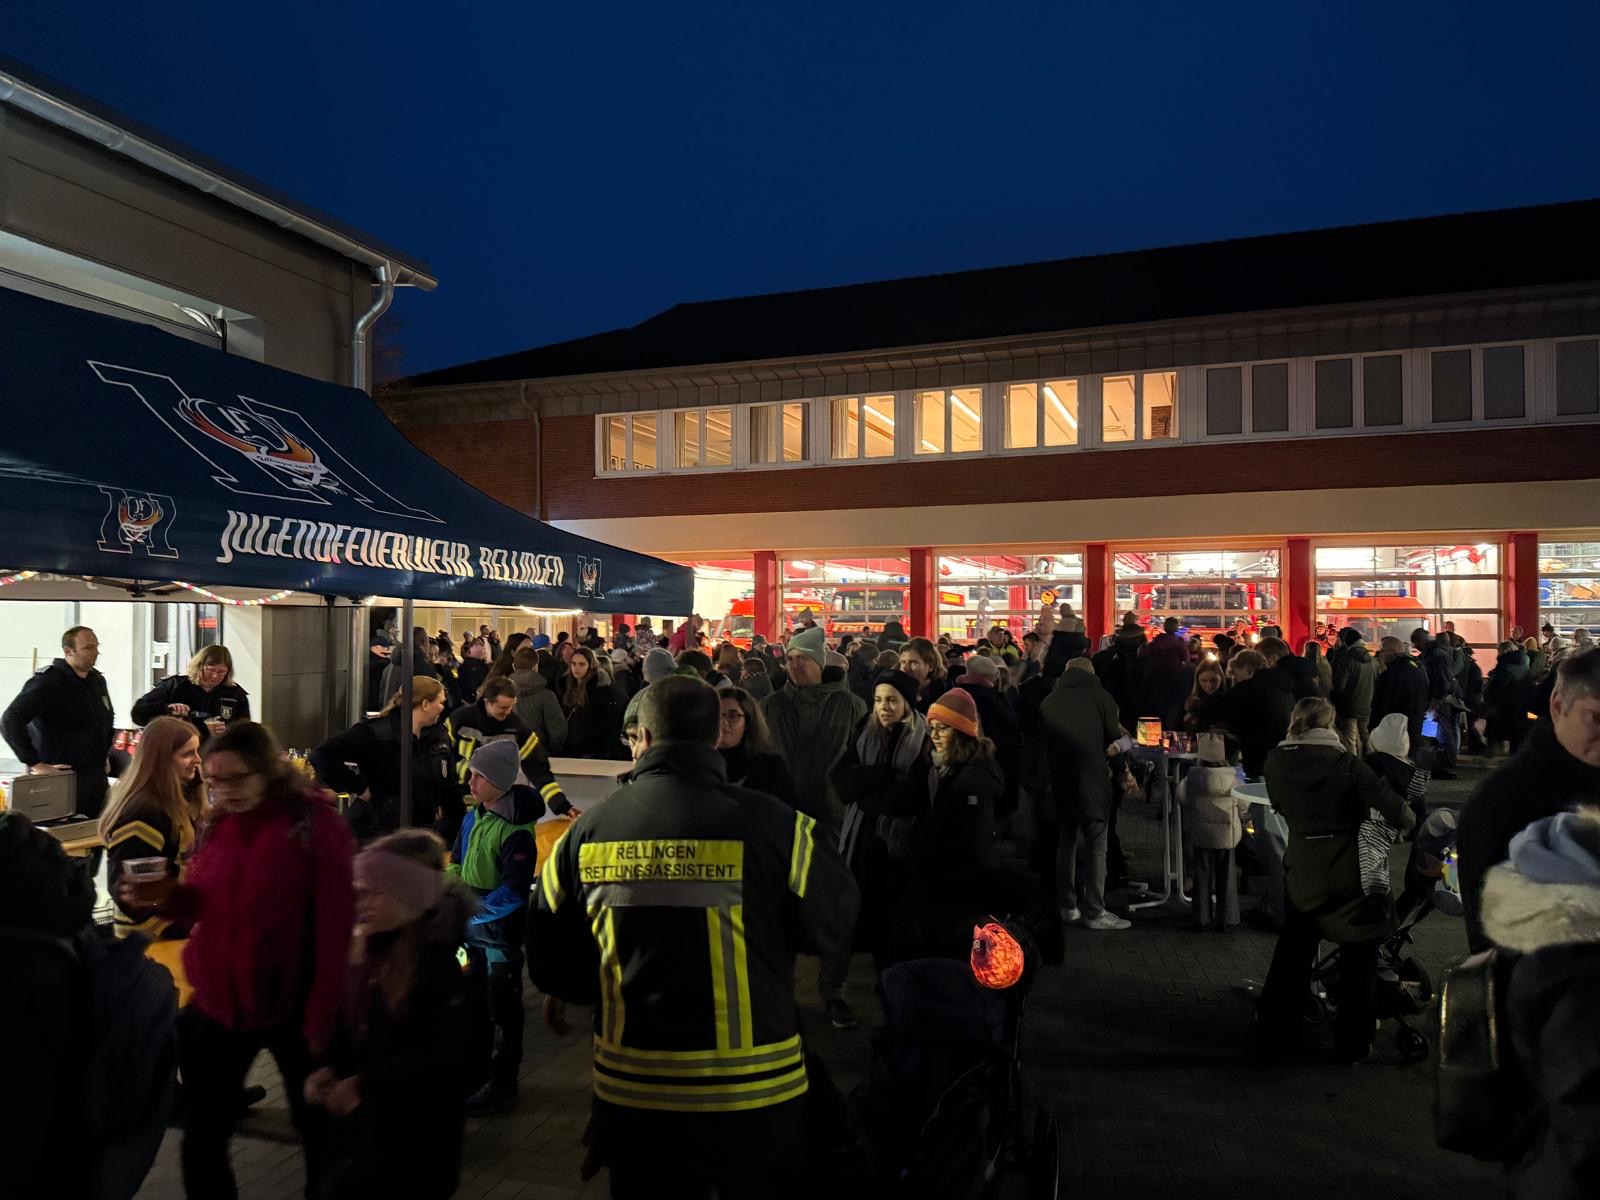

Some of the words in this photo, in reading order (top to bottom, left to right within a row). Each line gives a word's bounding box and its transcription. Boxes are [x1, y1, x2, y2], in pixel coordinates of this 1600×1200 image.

[216, 510, 474, 578] JUGENDFEUERWEHR
[479, 546, 564, 587] RELLINGEN
[616, 845, 695, 859] RELLINGEN
[584, 864, 736, 879] RETTUNGSASSISTENT
